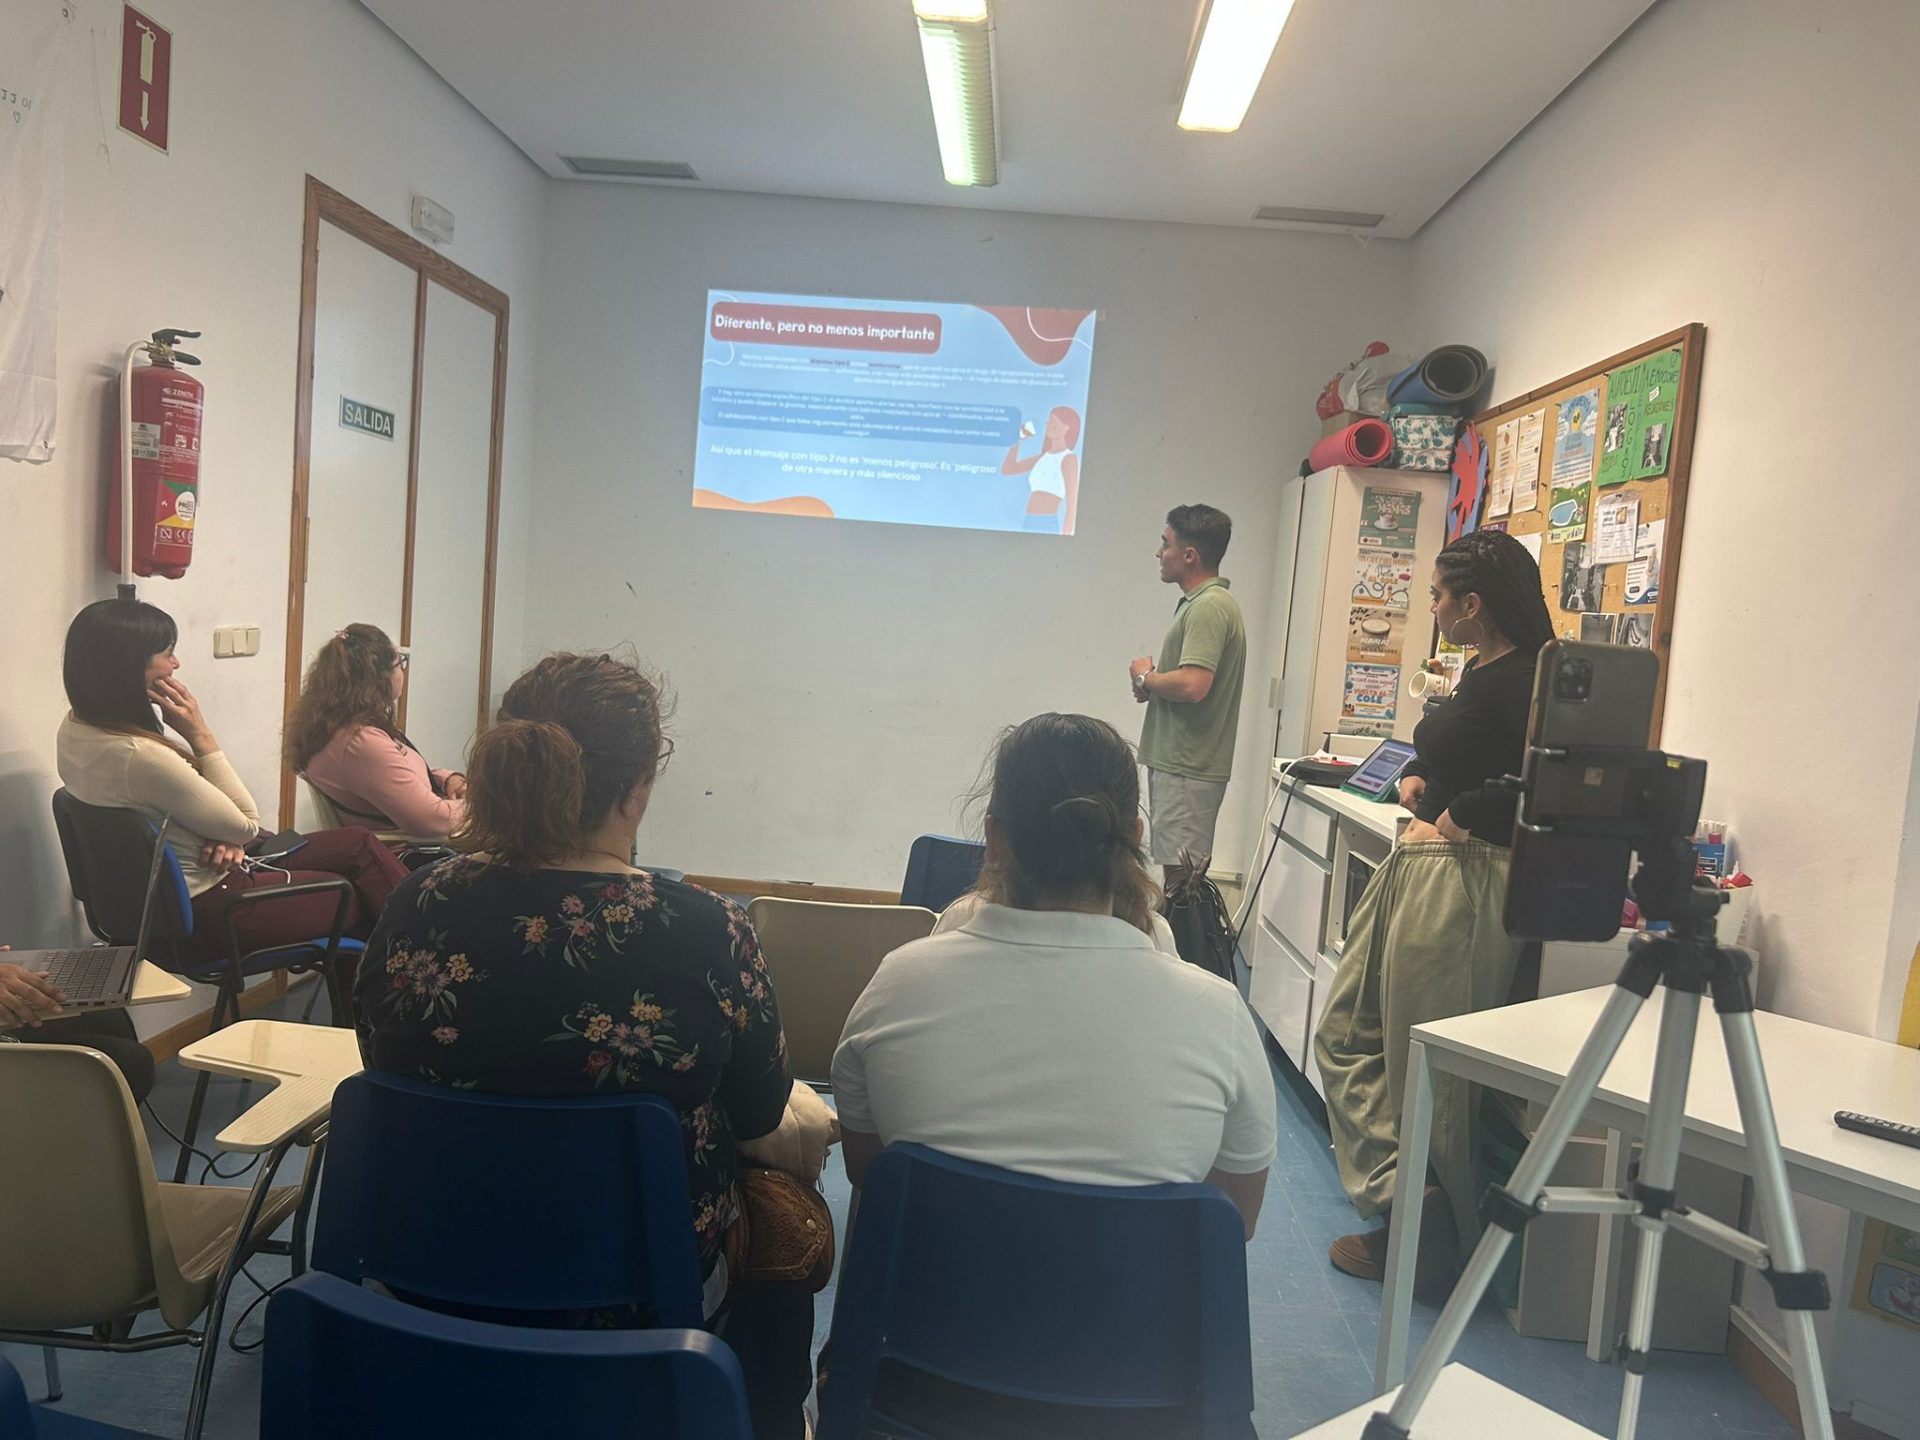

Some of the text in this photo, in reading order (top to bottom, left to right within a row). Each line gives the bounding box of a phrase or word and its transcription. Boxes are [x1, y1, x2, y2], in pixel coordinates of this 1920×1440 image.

[715, 315, 935, 341] Diferente, pero no menos importante
[345, 403, 391, 435] SALIDA
[710, 444, 723, 454] Así
[725, 446, 741, 457] que
[744, 446, 752, 457] el
[753, 448, 788, 461] mensaje
[791, 450, 808, 460] con
[810, 451, 827, 463] tipo
[828, 453, 834, 462] 2
[836, 454, 847, 464] no
[849, 456, 859, 465] es
[941, 460, 950, 471] Es
[782, 462, 921, 482] de otra manera y más silencioso
[1357, 695, 1383, 704] COLE
